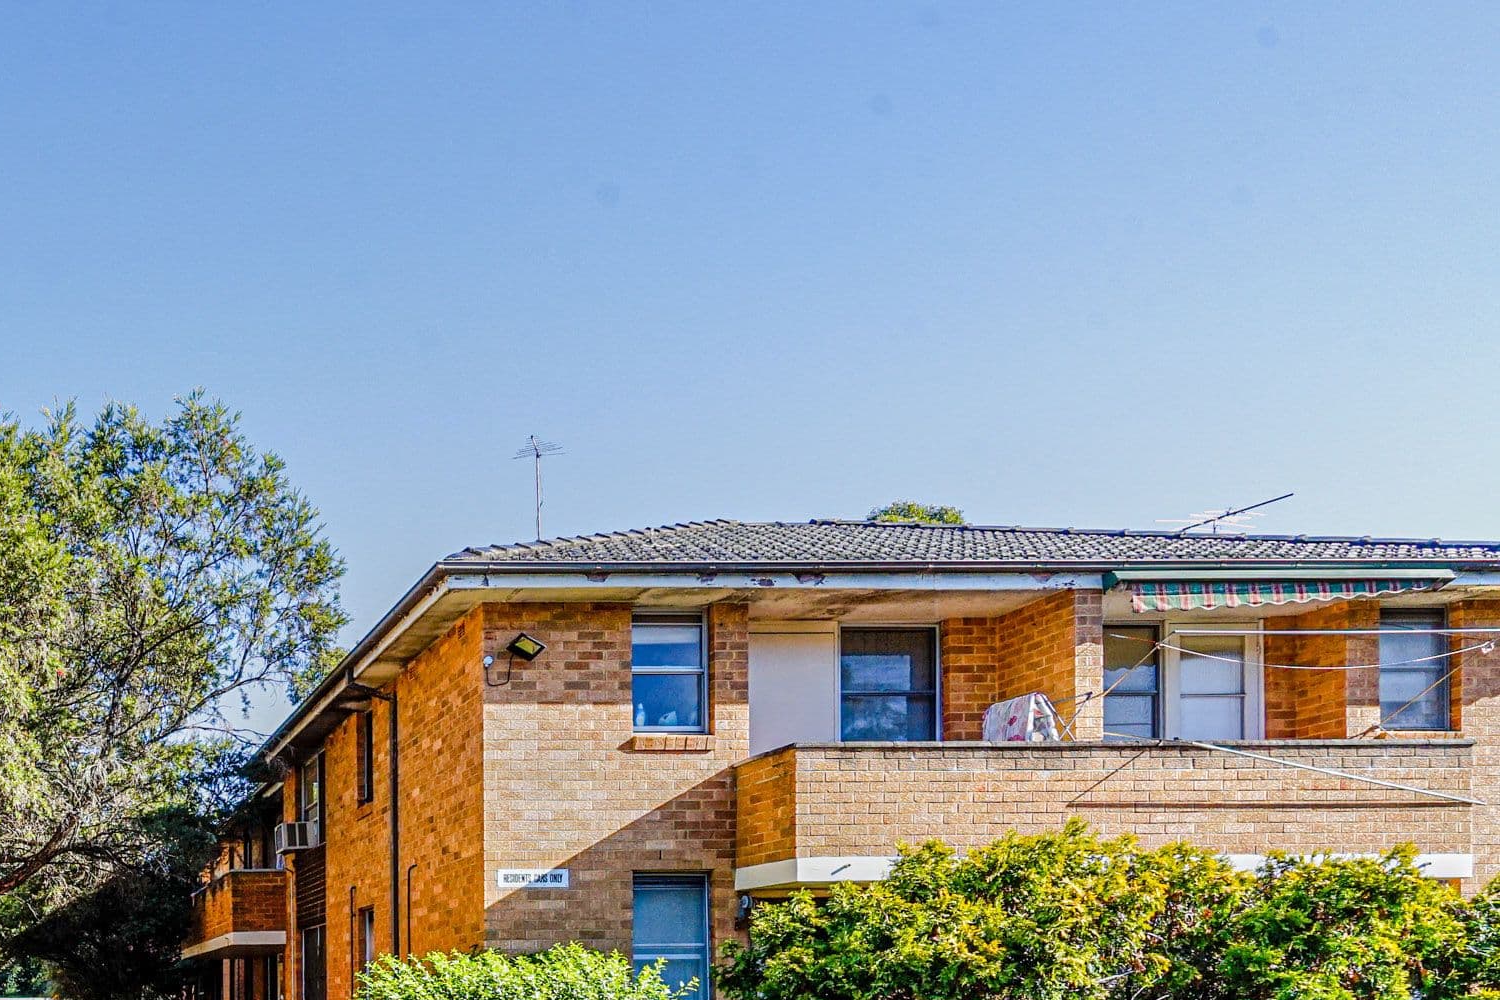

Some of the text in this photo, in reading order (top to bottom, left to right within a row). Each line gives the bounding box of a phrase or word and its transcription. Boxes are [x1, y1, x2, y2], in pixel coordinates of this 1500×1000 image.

[503, 873, 563, 884] RESIDENTS CARS ONLY
